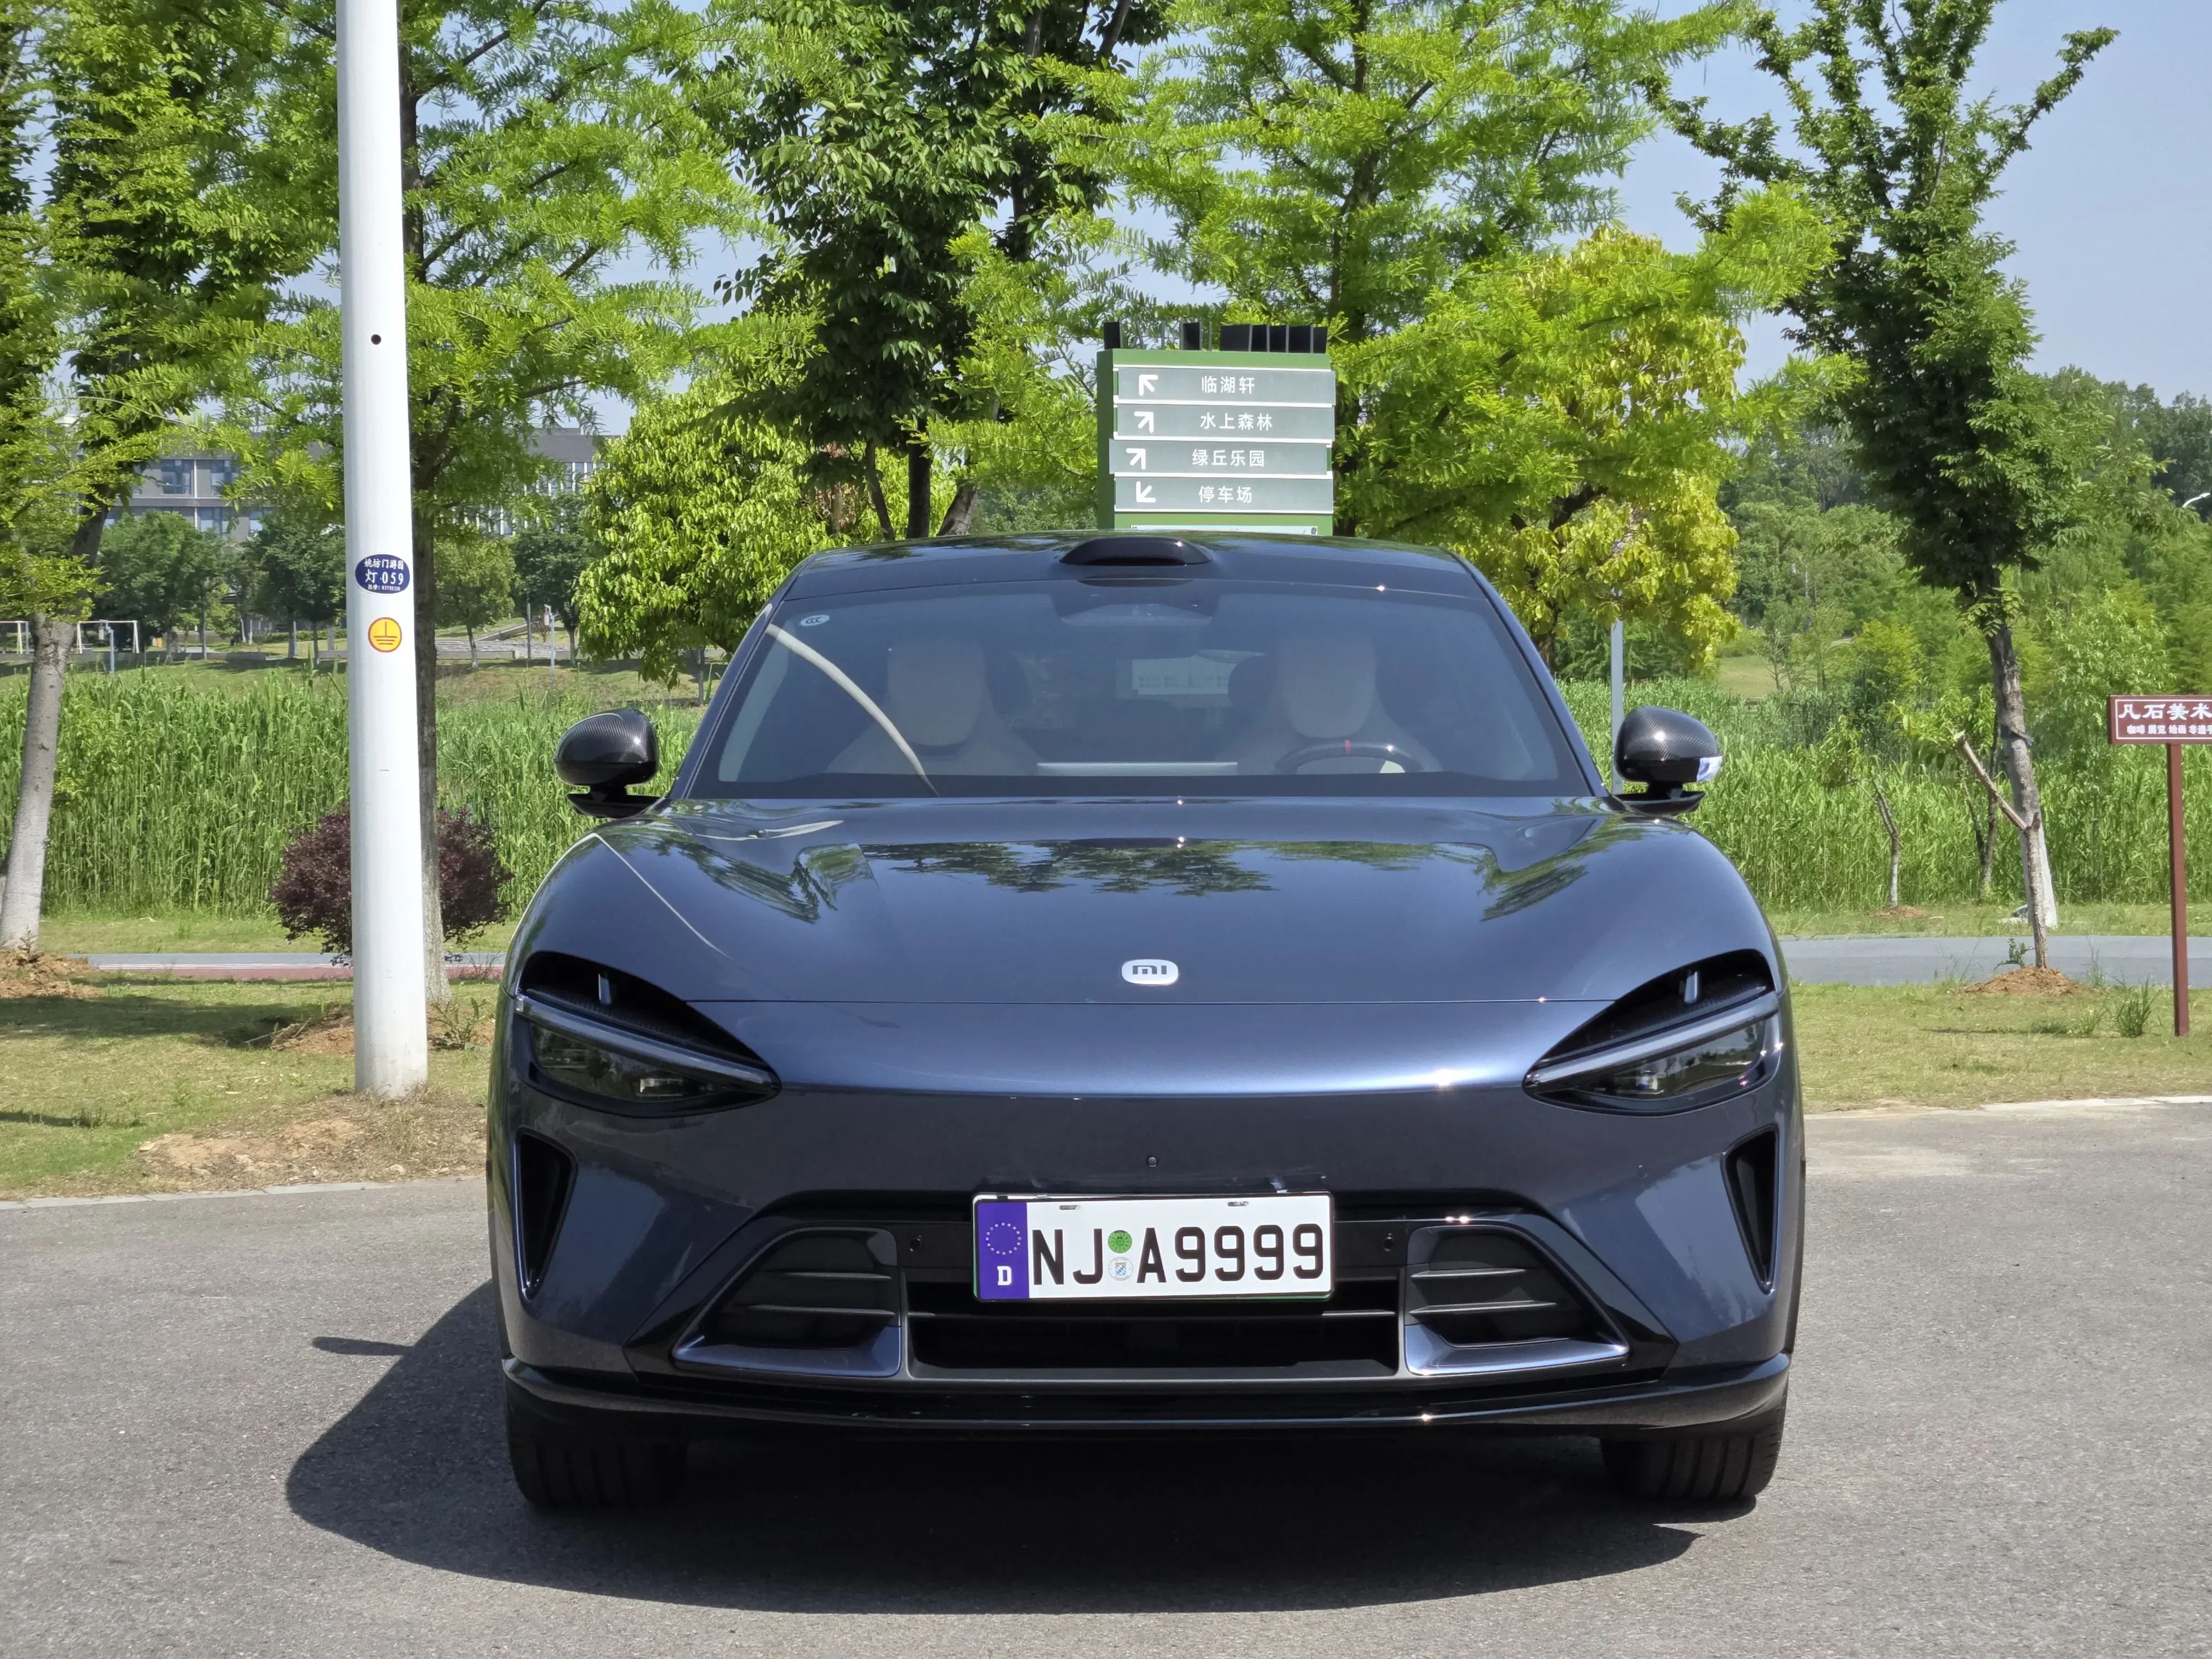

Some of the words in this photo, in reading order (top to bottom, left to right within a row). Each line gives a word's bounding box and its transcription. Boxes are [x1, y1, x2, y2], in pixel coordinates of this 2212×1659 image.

[1202, 375, 1255, 394] 临湖轩
[1200, 412, 1272, 431] 水上森林
[1192, 448, 1265, 467] 绿丘乐园
[1198, 486, 1252, 503] 停车场
[2118, 703, 2212, 721] 凡石美术
[1032, 1228, 1104, 1285] NJ
[1136, 1223, 1323, 1284] A9999
[997, 1266, 1012, 1286] D
